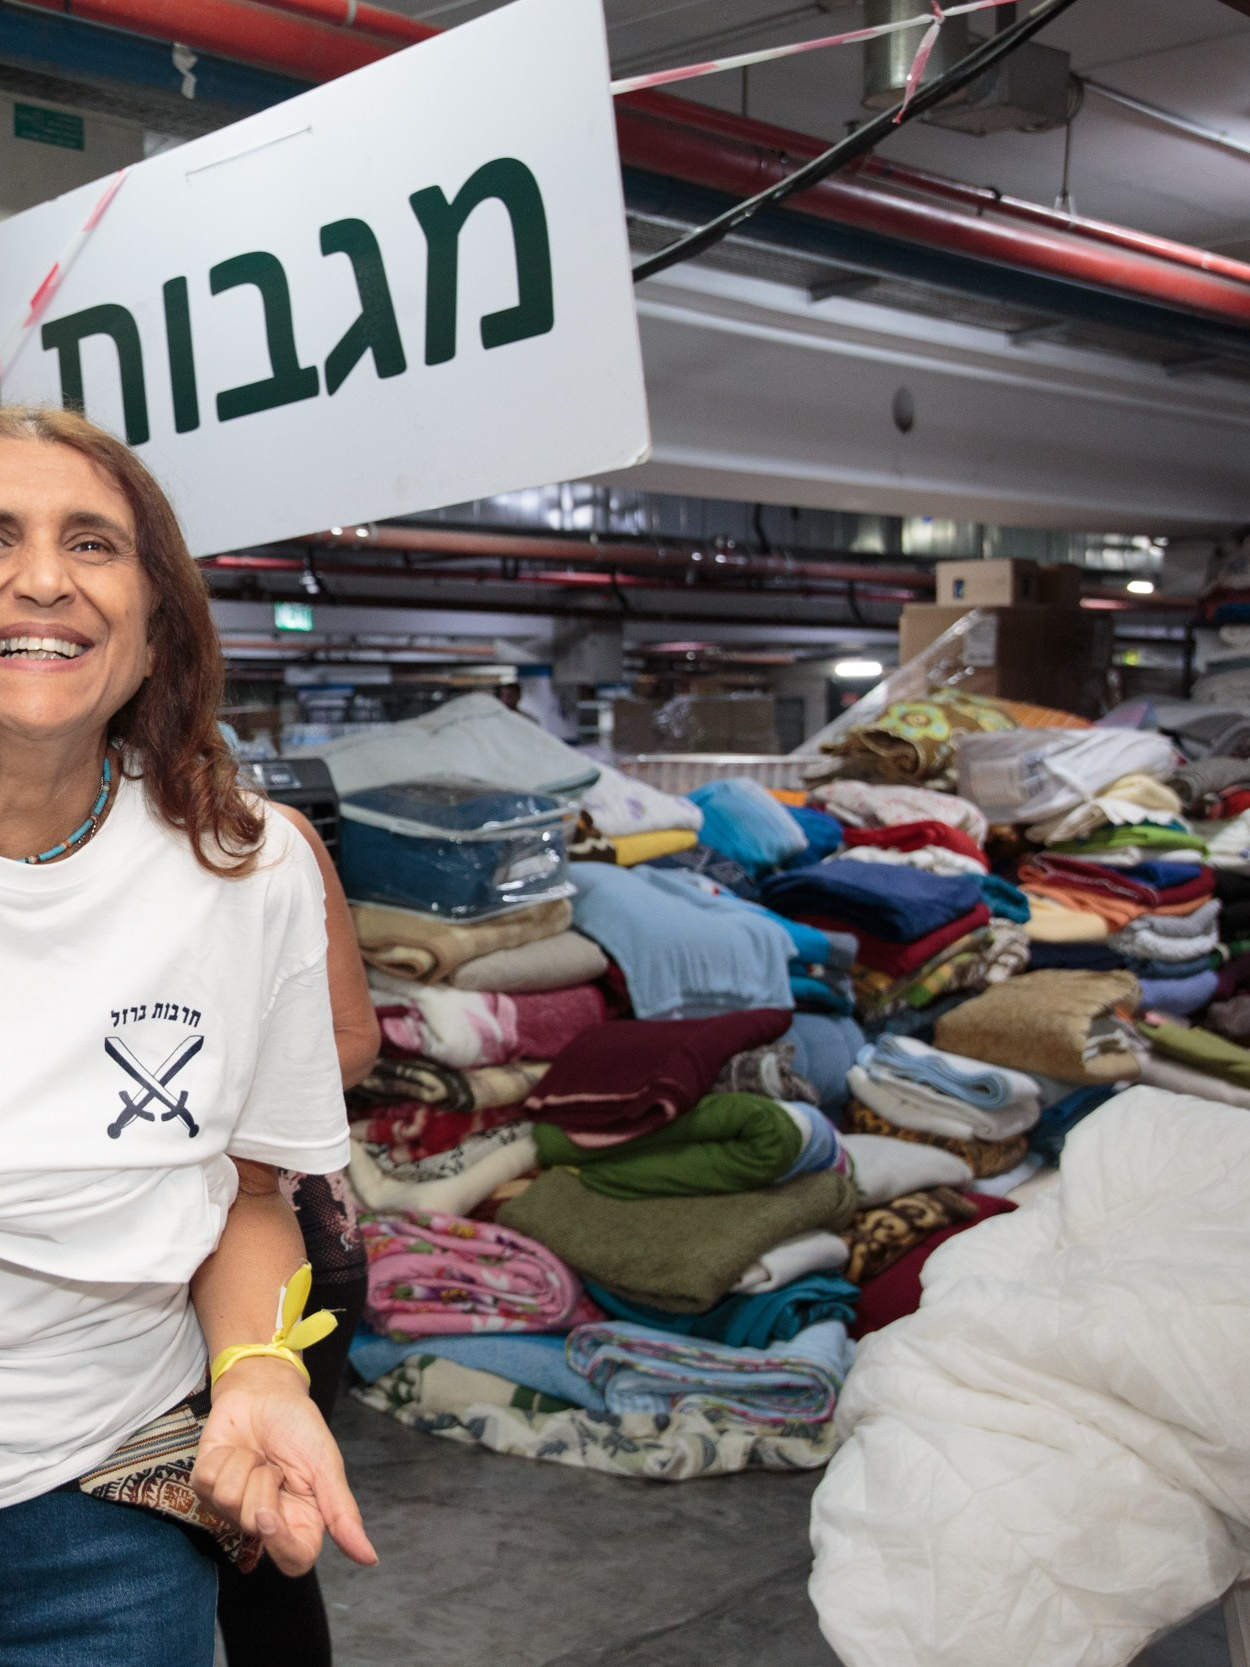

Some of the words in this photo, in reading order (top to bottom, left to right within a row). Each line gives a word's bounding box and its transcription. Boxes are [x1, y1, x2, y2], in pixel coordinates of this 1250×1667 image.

[41, 157, 554, 447] מגבות
[110, 1004, 147, 1028] ברזל
[151, 1002, 202, 1028] חרבות
